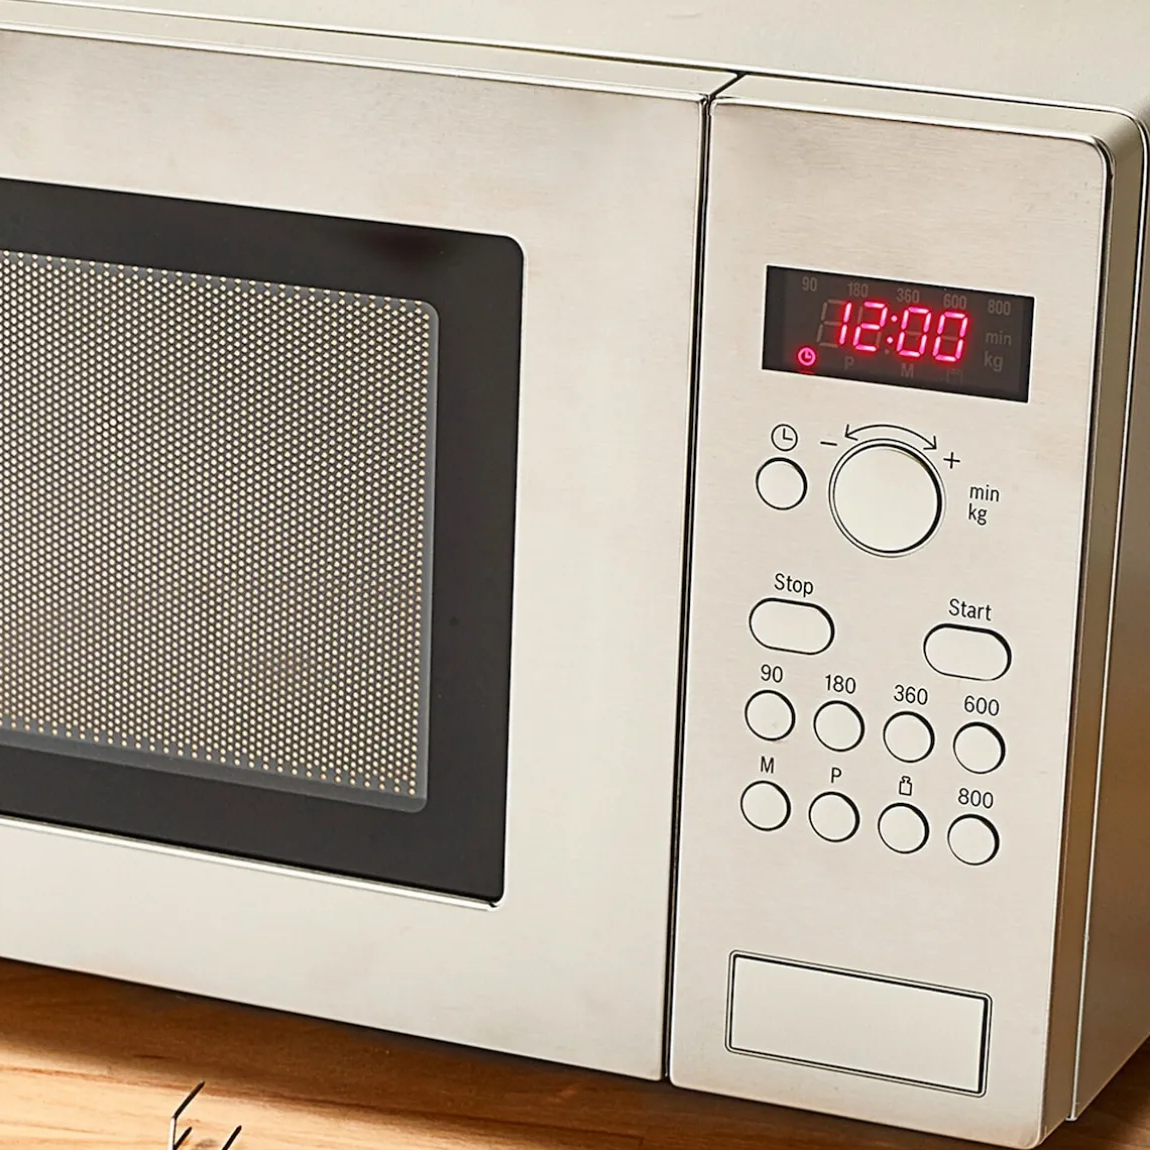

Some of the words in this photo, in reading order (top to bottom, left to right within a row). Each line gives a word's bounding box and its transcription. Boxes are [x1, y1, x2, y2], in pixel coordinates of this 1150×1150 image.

[801, 276, 818, 292] 90
[847, 282, 869, 298] 180
[896, 288, 920, 305] 360
[943, 294, 967, 310] 600
[987, 300, 1011, 316] 800
[839, 300, 968, 362] 12:00
[985, 330, 1012, 346] min
[984, 351, 1004, 372] kg
[900, 363, 914, 379] M
[969, 485, 1000, 502] min
[968, 503, 987, 525] kg
[774, 573, 814, 597] Stop
[948, 598, 992, 621] Start
[760, 664, 784, 683] 90
[825, 674, 856, 694] 180
[893, 685, 928, 705] 360
[963, 695, 999, 716] 600
[760, 756, 775, 774] M
[831, 767, 842, 783] P
[957, 788, 994, 809] 800
